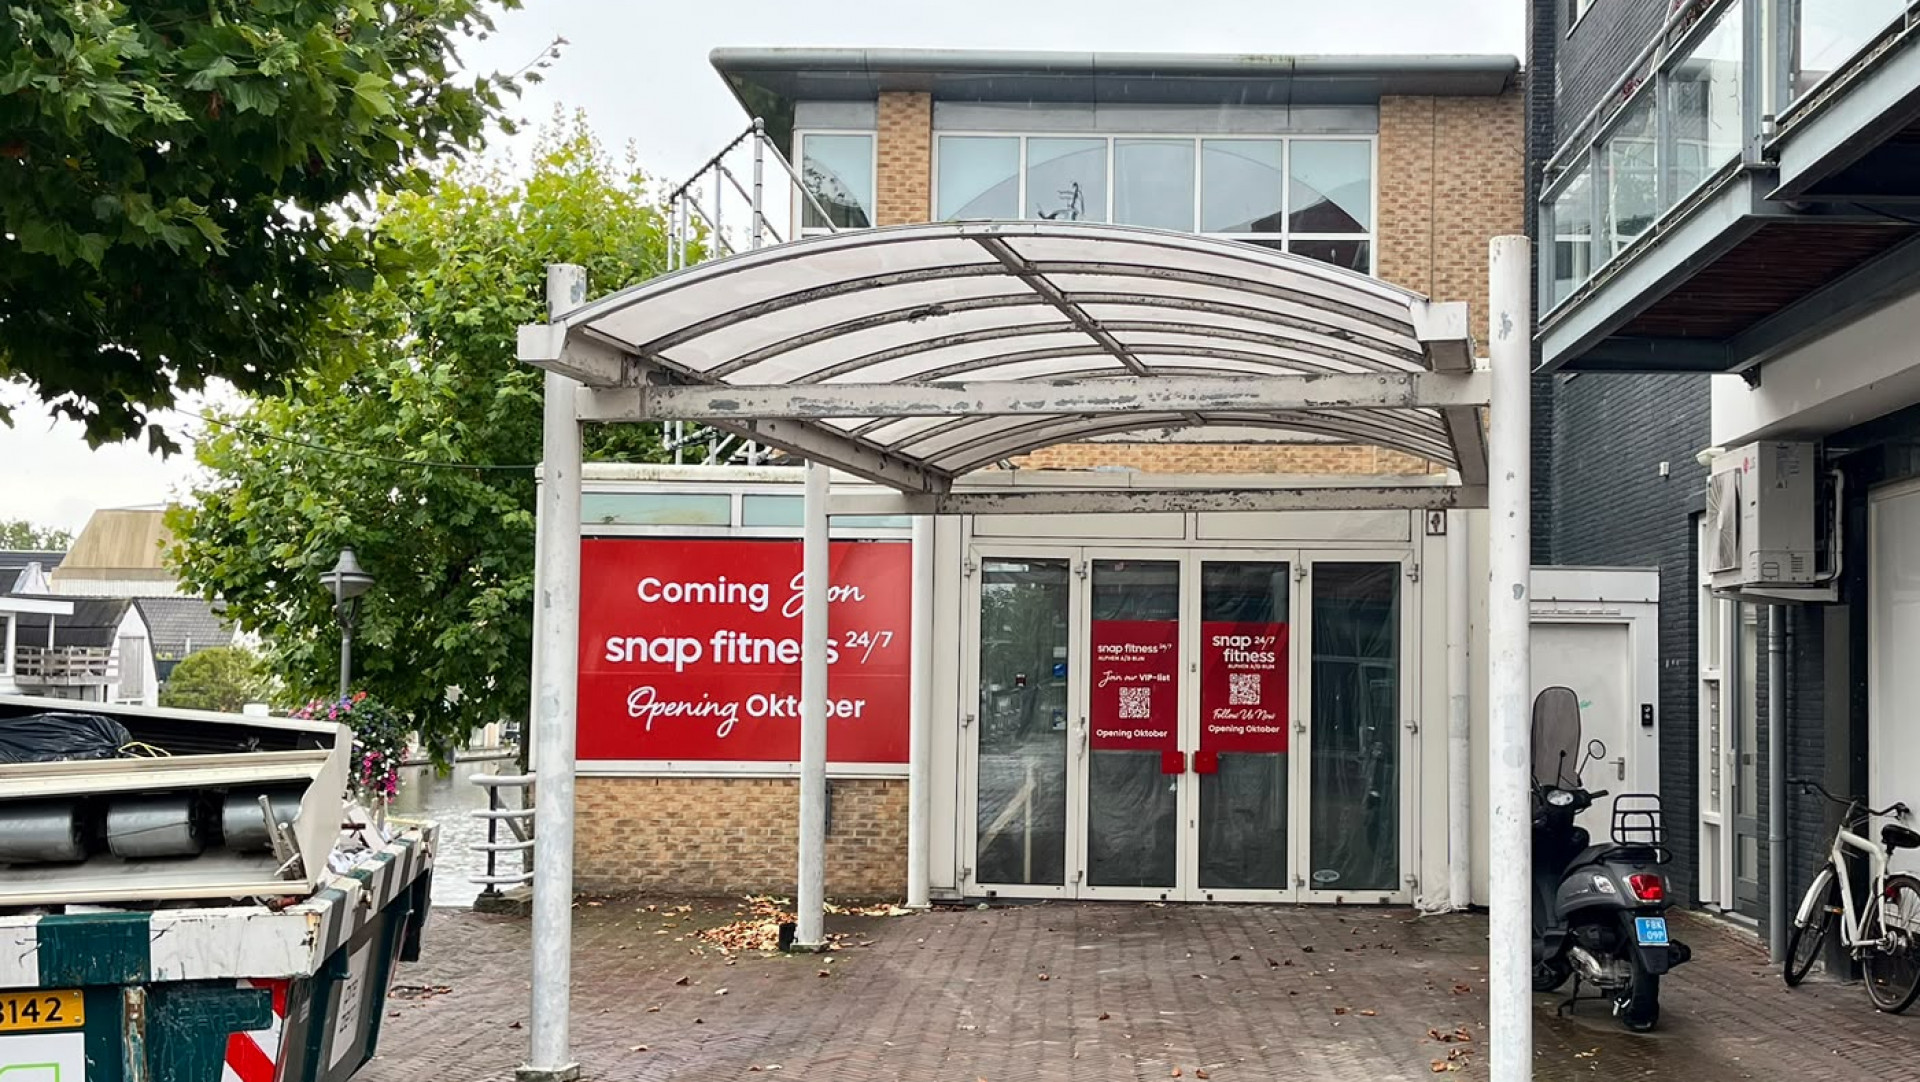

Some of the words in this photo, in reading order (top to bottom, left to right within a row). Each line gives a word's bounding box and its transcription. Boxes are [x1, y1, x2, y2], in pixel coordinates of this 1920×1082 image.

[637, 576, 769, 612] Coming
[781, 570, 866, 618] Son
[1097, 645, 1123, 655] snap
[1125, 643, 1158, 654] fitness
[1212, 635, 1252, 651] snap
[1254, 635, 1275, 651] 24/7
[605, 636, 702, 673] snap
[709, 630, 839, 665] fitnes
[844, 630, 894, 665] 24/7
[1223, 648, 1275, 663] fitness
[1098, 670, 1122, 688] Join
[1139, 673, 1171, 682] VIP-list
[627, 686, 739, 738] Opening
[1213, 708, 1239, 720] Follow
[1240, 708, 1255, 720] Us
[1255, 708, 1276, 721] Now
[1096, 729, 1132, 739] Opening
[1133, 729, 1168, 738] Oktober
[1208, 724, 1245, 735] Opening
[1245, 725, 1280, 733] Oktober
[0, 997, 63, 1024] 142
